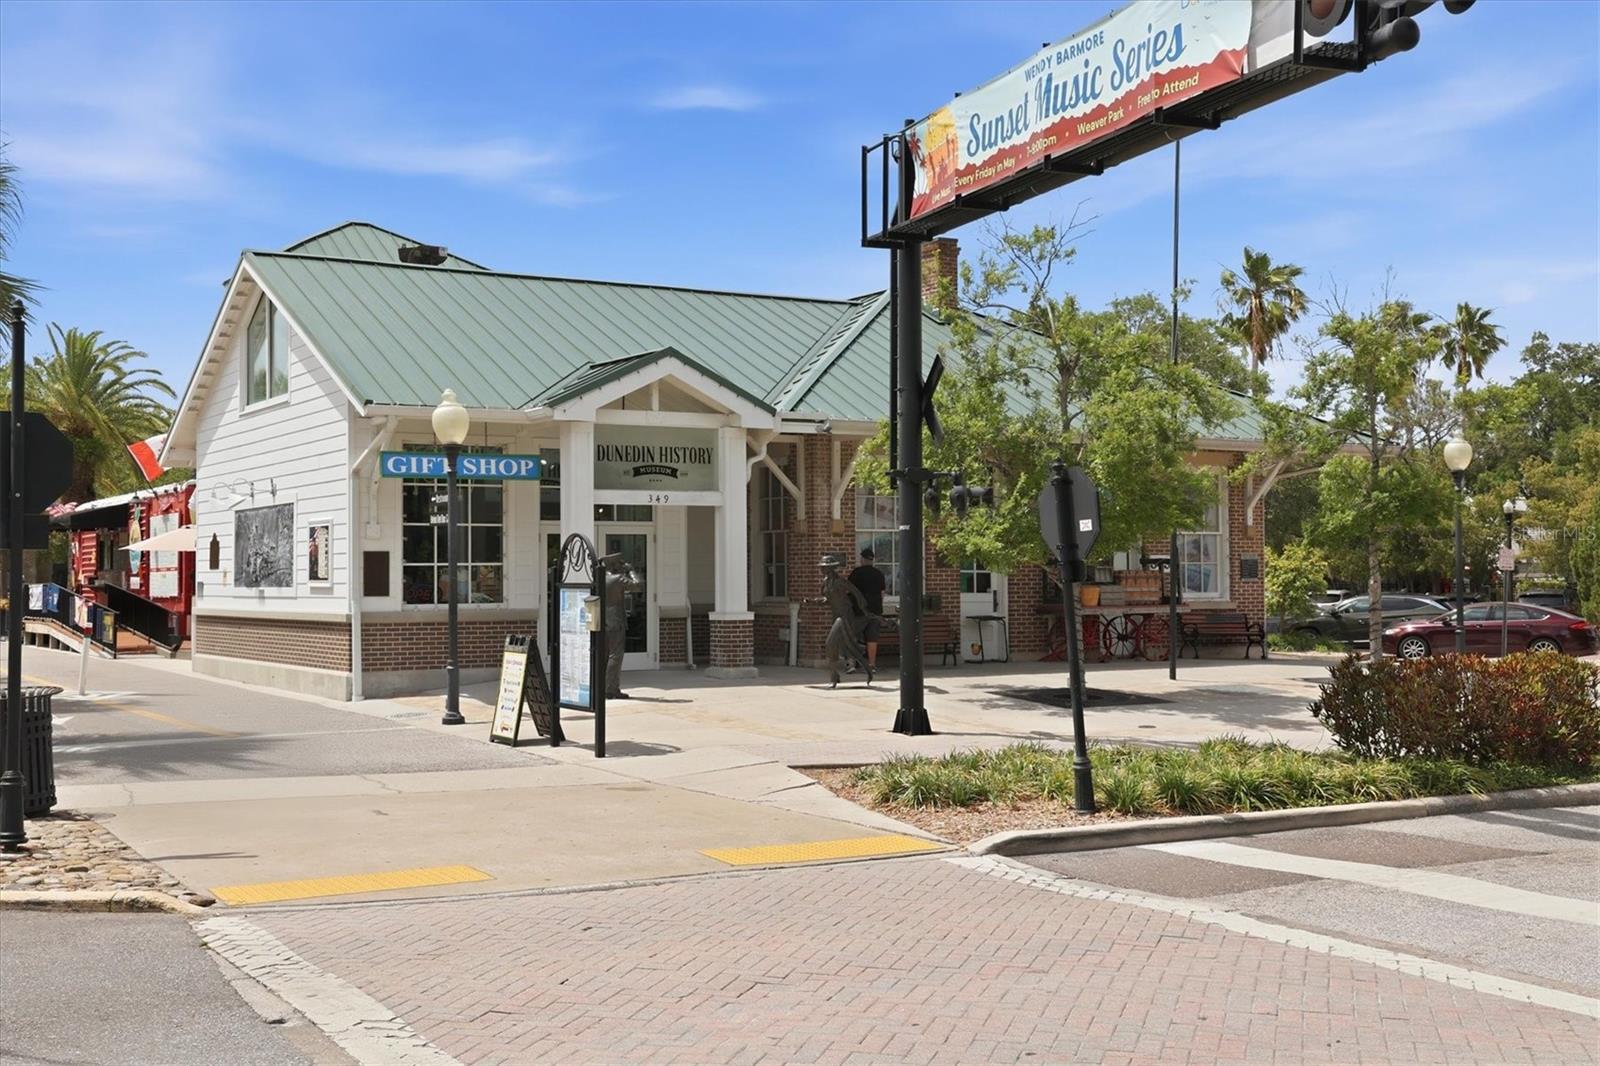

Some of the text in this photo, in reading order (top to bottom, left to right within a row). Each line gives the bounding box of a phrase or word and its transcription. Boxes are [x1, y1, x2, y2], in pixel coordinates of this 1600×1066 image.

[1024, 31, 1105, 82] WENDY BARMORE
[966, 23, 1187, 157] Sunset Music Series
[954, 171, 975, 187] Every
[975, 164, 996, 183] Friday
[997, 162, 1003, 174] in
[1003, 157, 1016, 172] May
[1077, 113, 1108, 136] Weaver
[1108, 106, 1125, 123] Park
[1137, 94, 1151, 109] Free
[1151, 88, 1160, 99] to
[1162, 72, 1199, 96] Attend
[387, 456, 534, 476] GIFT SHOP
[596, 444, 713, 465] DUNEDIN HISTORY
[639, 466, 673, 474] MUSEUM
